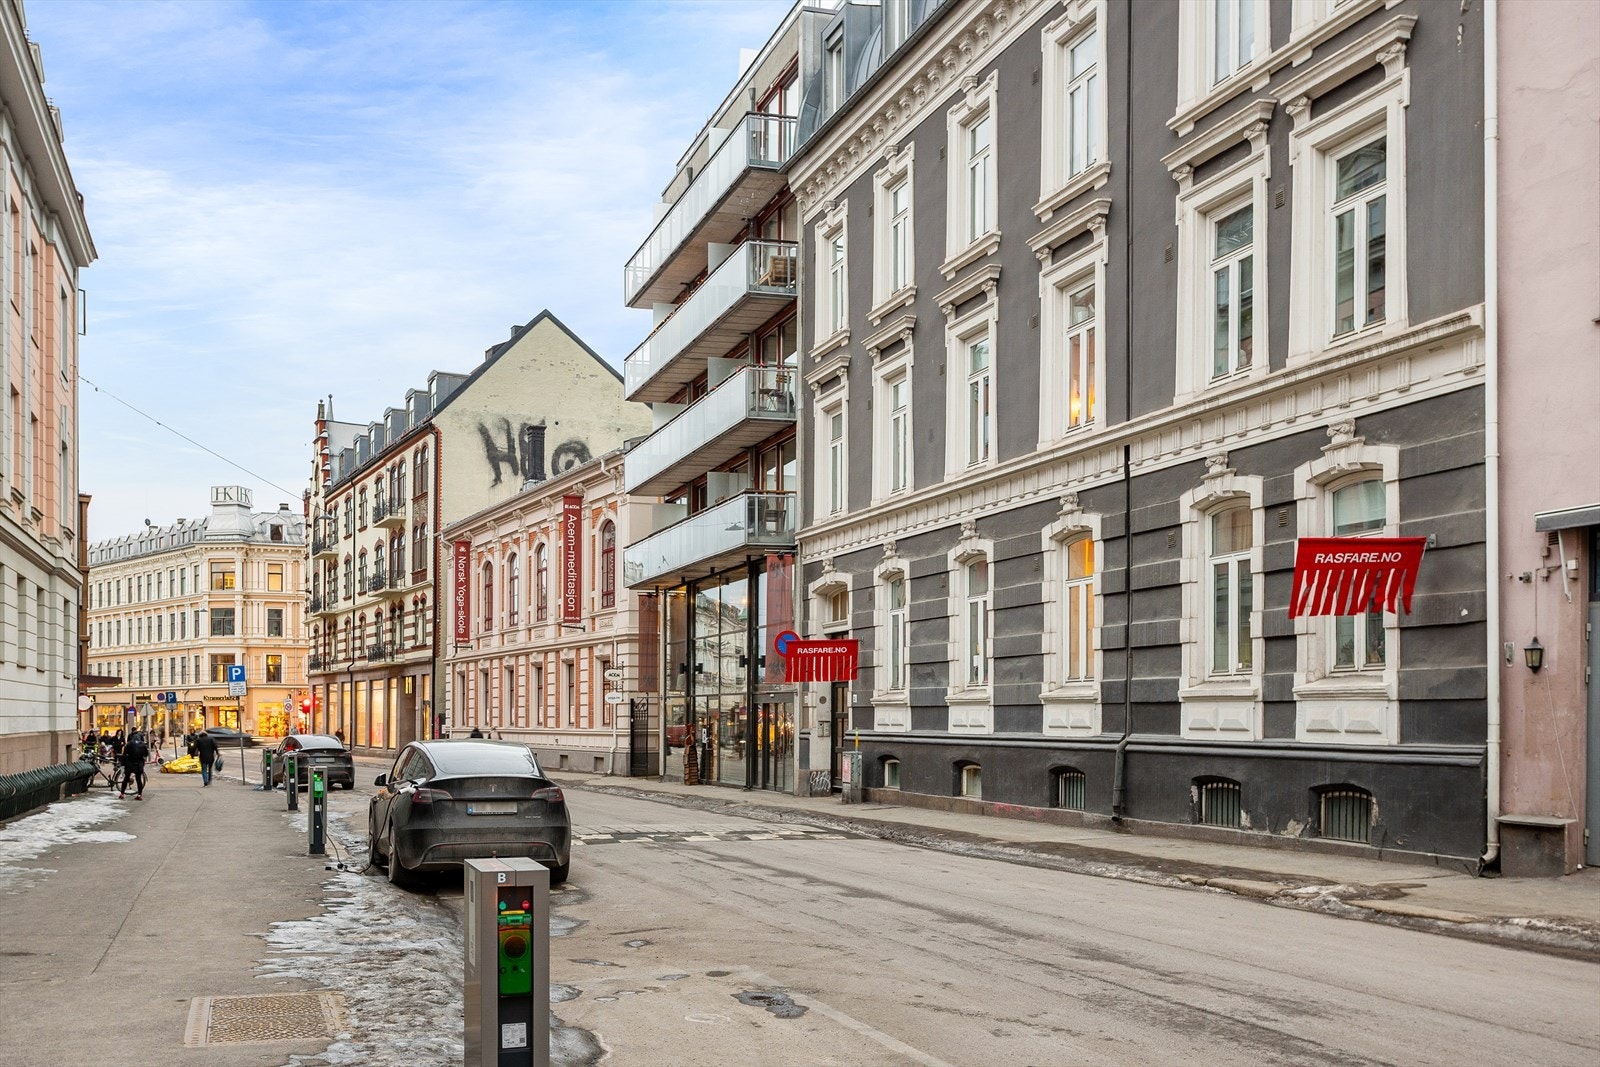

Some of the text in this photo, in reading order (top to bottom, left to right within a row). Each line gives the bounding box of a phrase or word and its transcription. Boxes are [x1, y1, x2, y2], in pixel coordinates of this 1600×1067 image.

[565, 513, 577, 612] Acem-meditasjon
[1314, 552, 1402, 564] RASFARE.NO
[456, 556, 467, 634] Norsk Yoga-skole
[797, 646, 848, 655] RASFARE.NO
[232, 667, 241, 680] P
[168, 693, 174, 702] P
[497, 872, 507, 883] B
